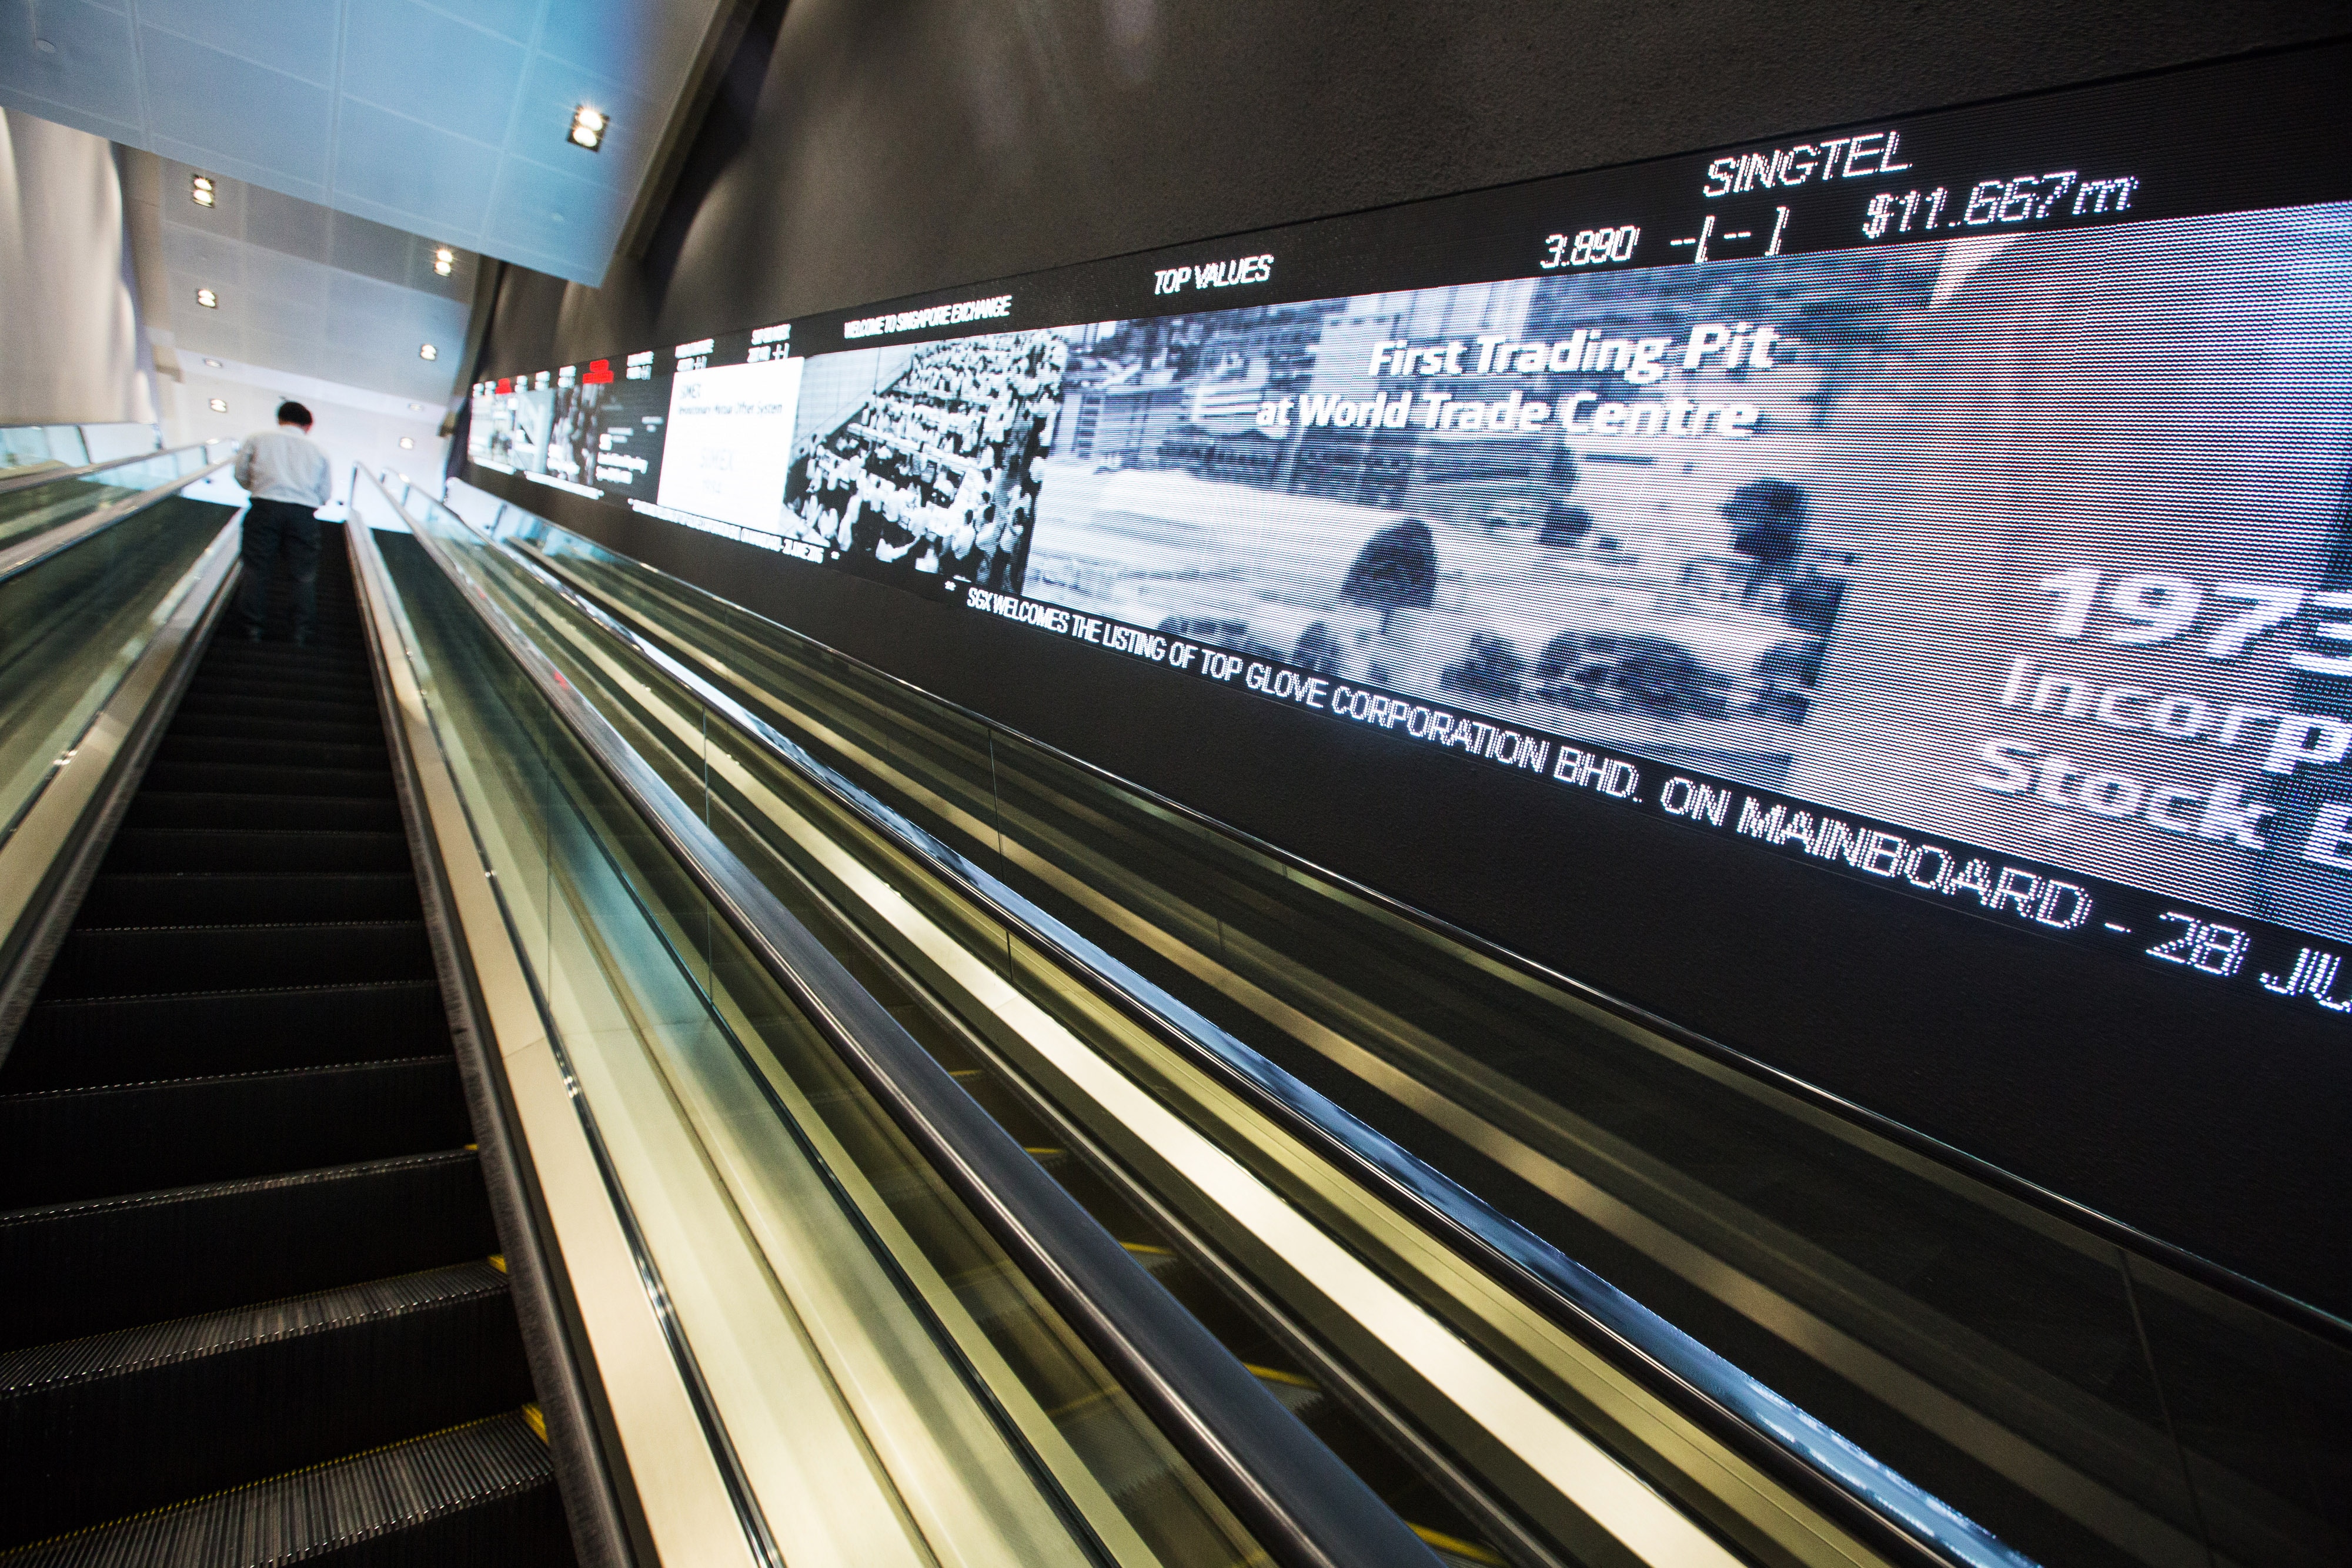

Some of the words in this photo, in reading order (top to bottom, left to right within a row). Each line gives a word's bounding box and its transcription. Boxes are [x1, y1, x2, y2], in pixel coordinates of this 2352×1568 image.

[1704, 131, 1912, 197] SINGTEL
[1154, 266, 1192, 295] TOP
[1194, 254, 1274, 289] VALUES
[1541, 225, 1641, 269] 3.890
[844, 315, 885, 339] WELCOME
[884, 313, 897, 334] TO
[896, 305, 953, 332] SINGAPORE
[951, 295, 1013, 324] EXCHANGE
[1369, 340, 1467, 377] First
[1476, 329, 1673, 385] Trading
[1681, 321, 1780, 370] Pit
[1255, 395, 1292, 429] at
[1298, 389, 1413, 430] World
[1423, 389, 1549, 433] Trade
[1562, 392, 1759, 437] Centre
[967, 587, 994, 612] SGX
[993, 593, 1070, 634] WELCOMES
[1071, 612, 1102, 643] THE
[1102, 623, 1167, 661] LISTING
[1169, 641, 1198, 669] OF
[1201, 648, 1243, 682] TOP
[1245, 662, 1329, 708] GLOVE
[1331, 685, 1551, 774] CORPORATION
[1553, 745, 1643, 804] BHD.
[1660, 775, 1732, 827] ON
[1736, 795, 2094, 930] MAINBOARD
[2145, 911, 2251, 977] 28
[1972, 739, 2278, 851] Stock
